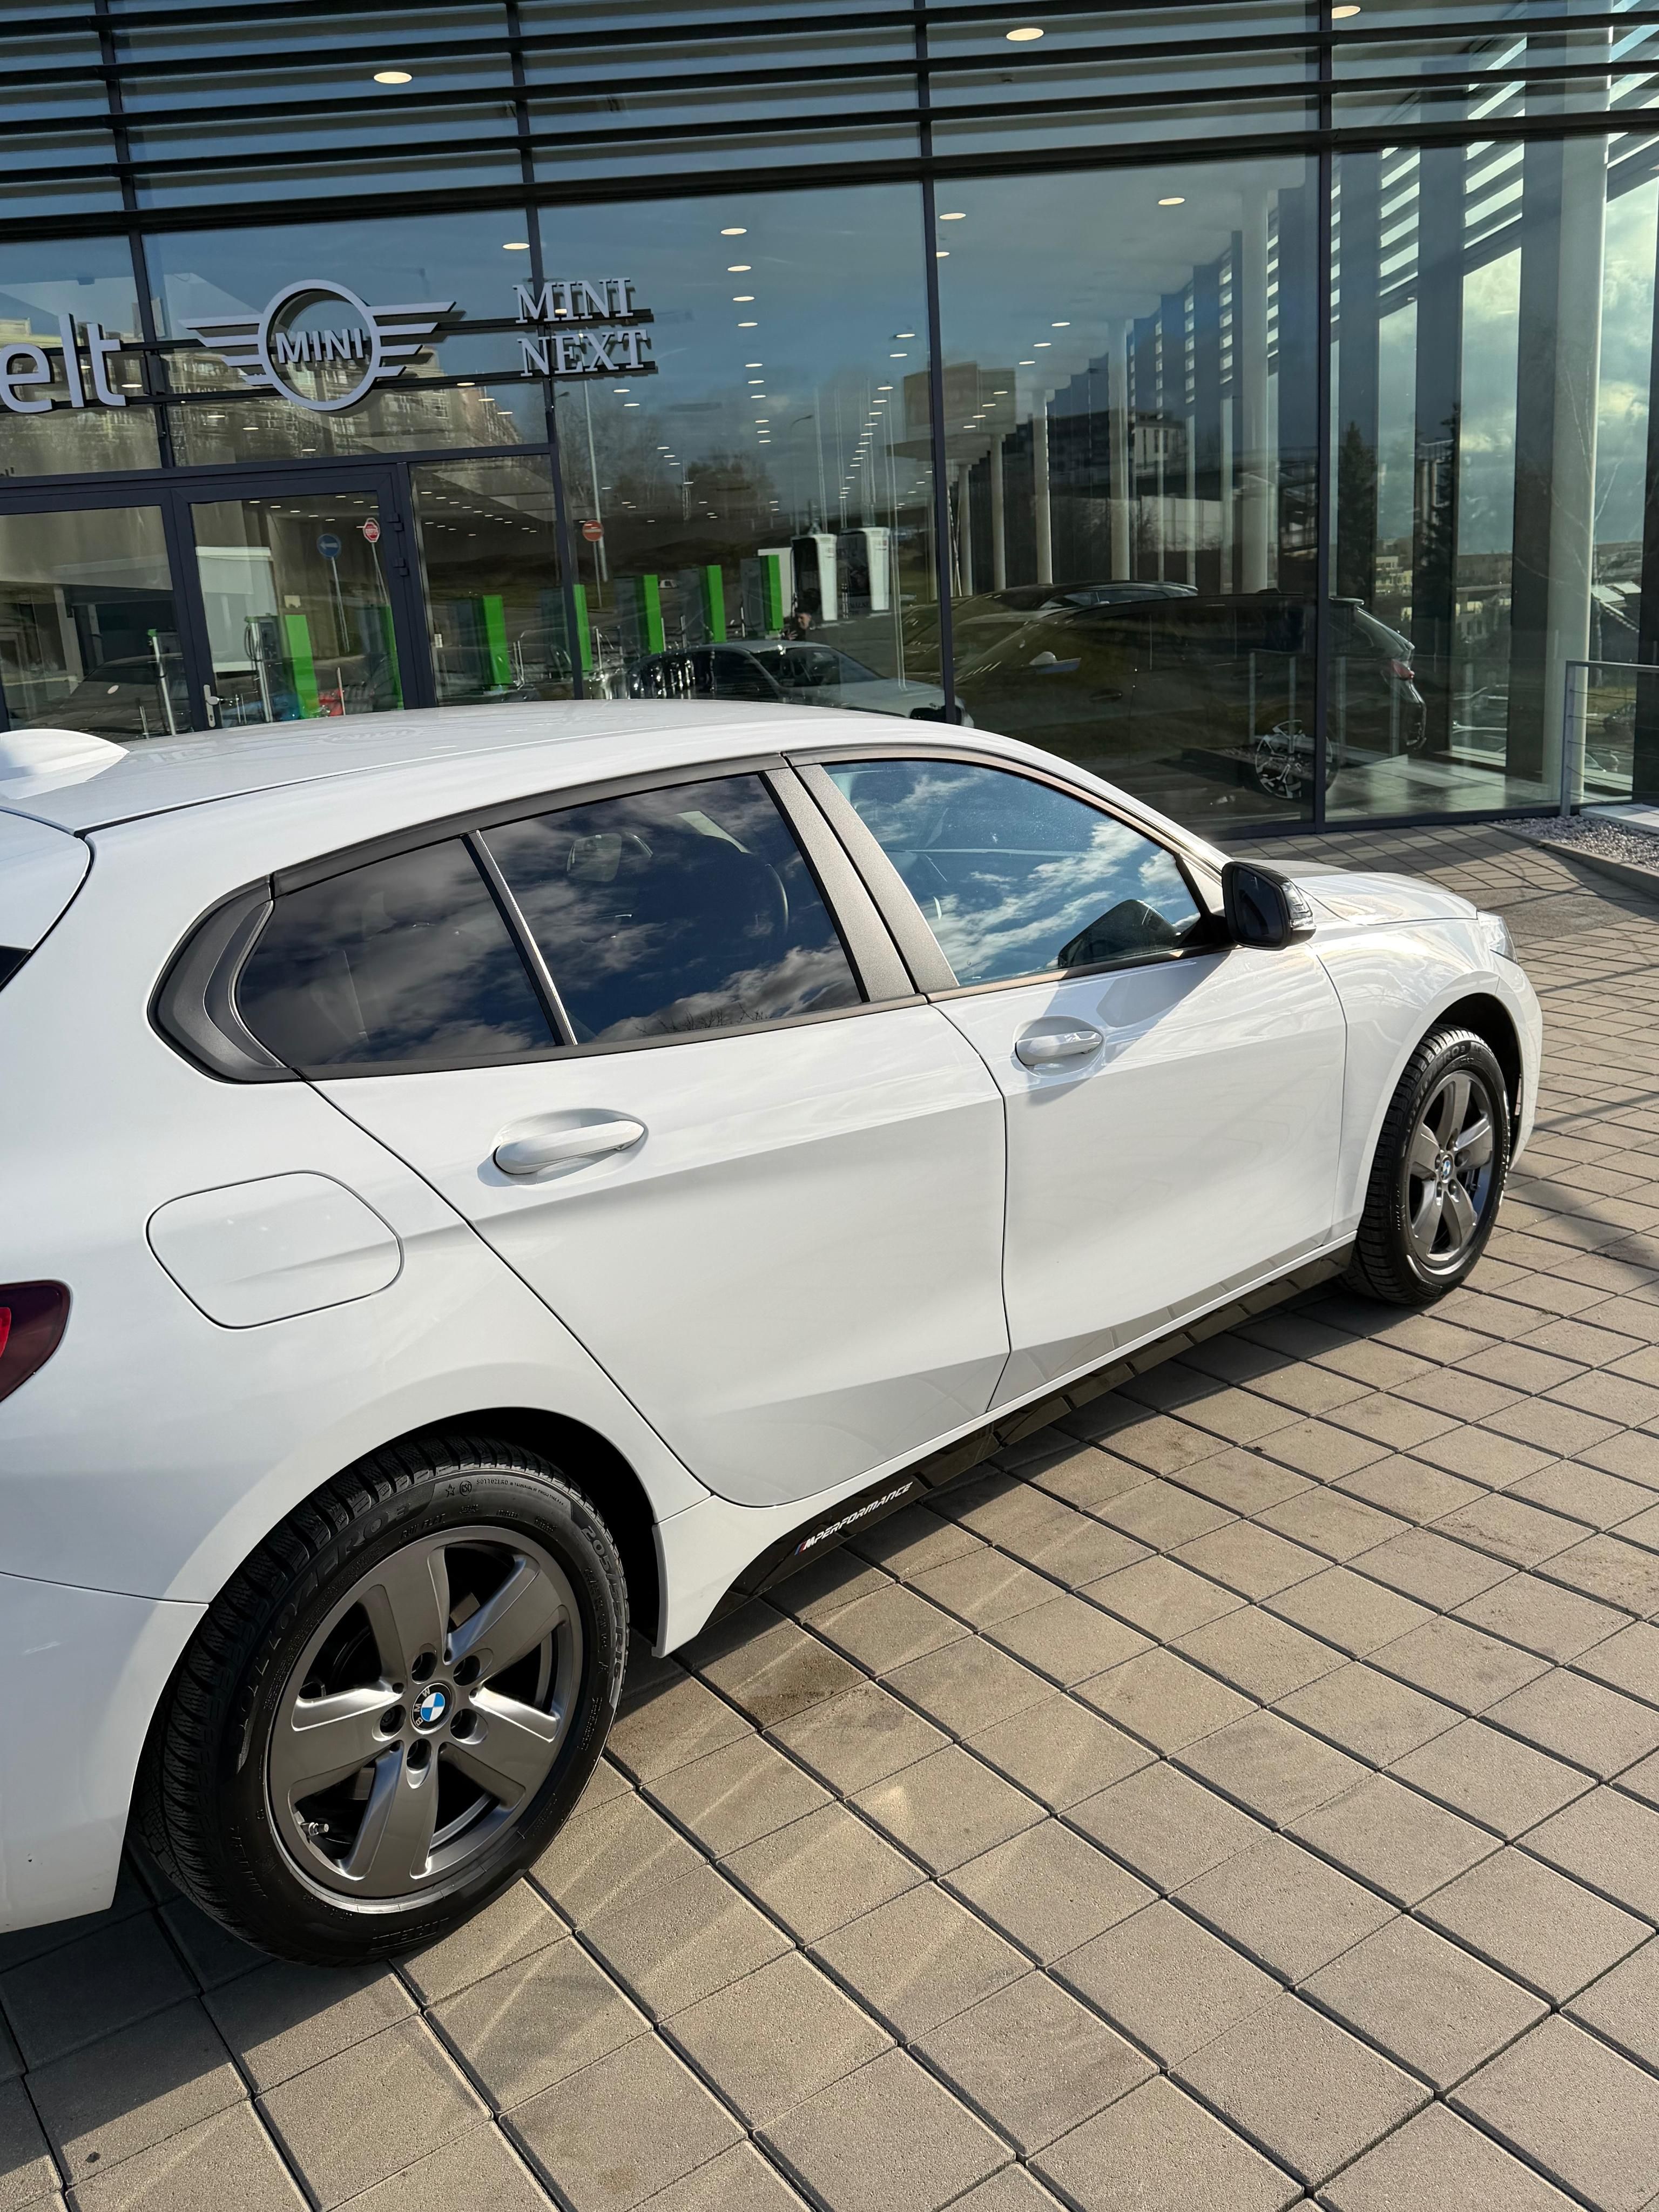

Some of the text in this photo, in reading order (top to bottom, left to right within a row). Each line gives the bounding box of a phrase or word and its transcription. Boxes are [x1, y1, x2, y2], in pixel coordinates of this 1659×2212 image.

[512, 278, 633, 323] MINI
[0, 313, 126, 414] elt
[275, 328, 363, 363] MINI
[517, 329, 647, 376] NEXT
[581, 1525, 626, 1620] 205/55
[414, 1687, 430, 1725] BMW
